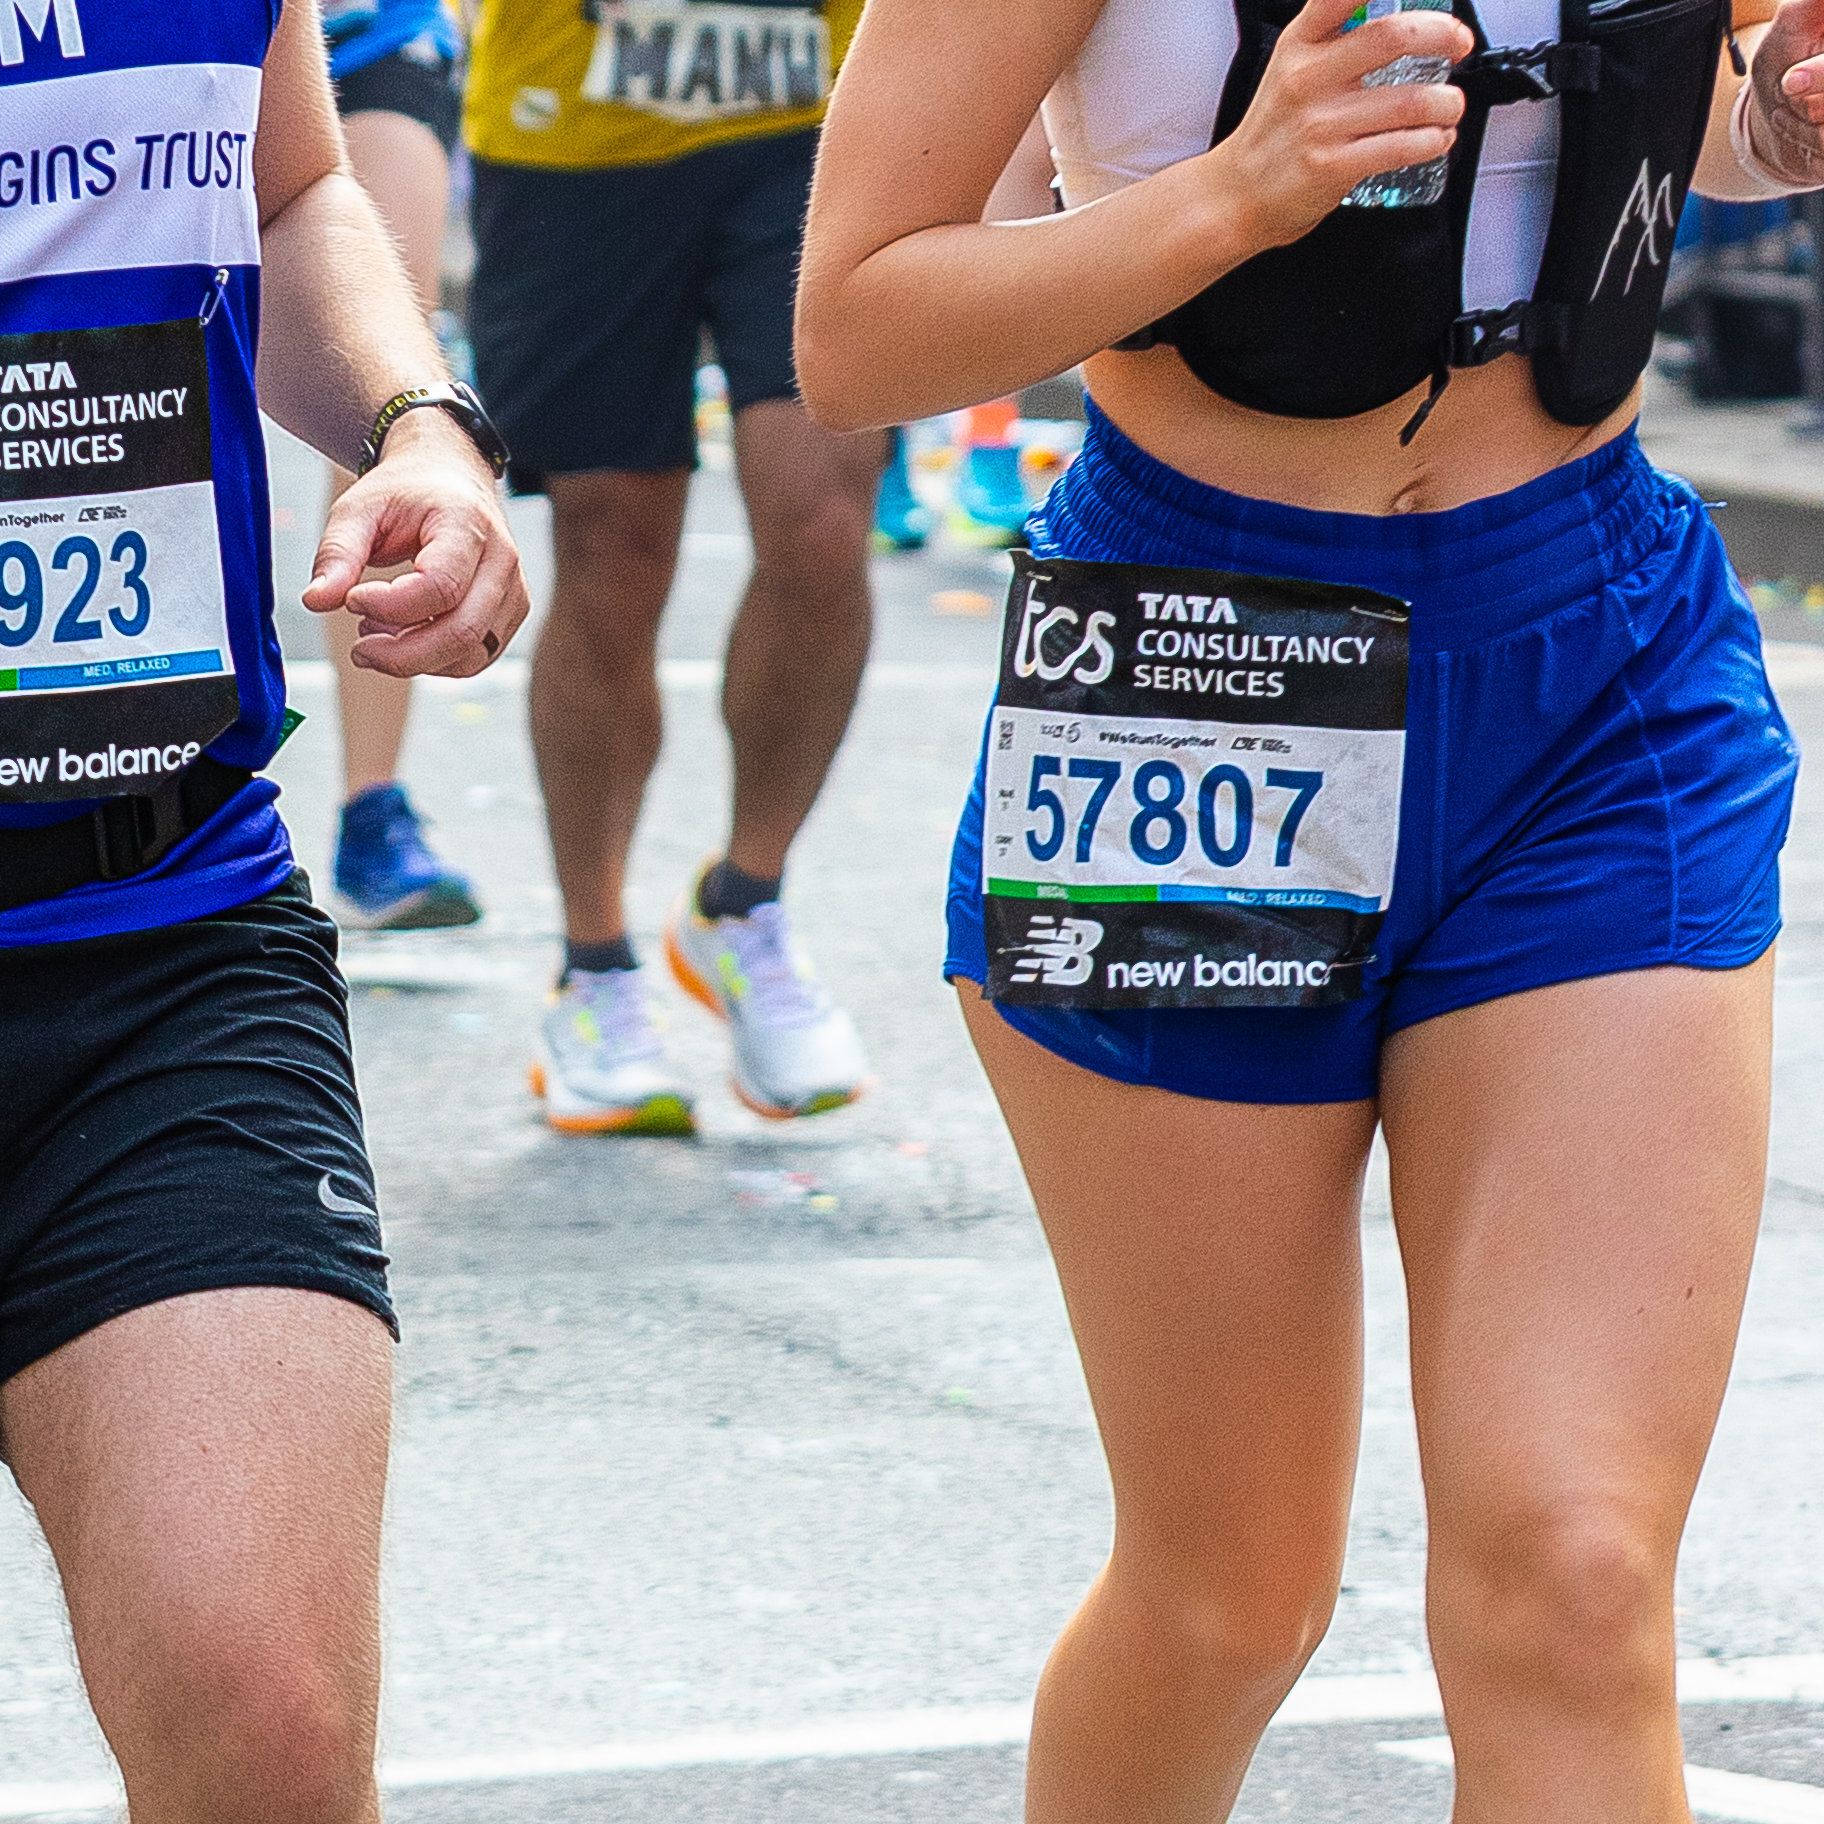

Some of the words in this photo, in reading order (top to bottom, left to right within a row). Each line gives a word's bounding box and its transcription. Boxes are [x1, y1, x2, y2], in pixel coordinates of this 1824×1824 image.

[1138, 592, 1238, 625] TATA
[1014, 579, 1116, 684] tcs
[1136, 629, 1374, 664] CONSULTANCY
[116, 657, 171, 676] RELAXED
[1133, 665, 1285, 698] SERVICES
[58, 741, 201, 782] balance
[1025, 754, 1324, 869] 57807
[1107, 961, 1186, 989] new
